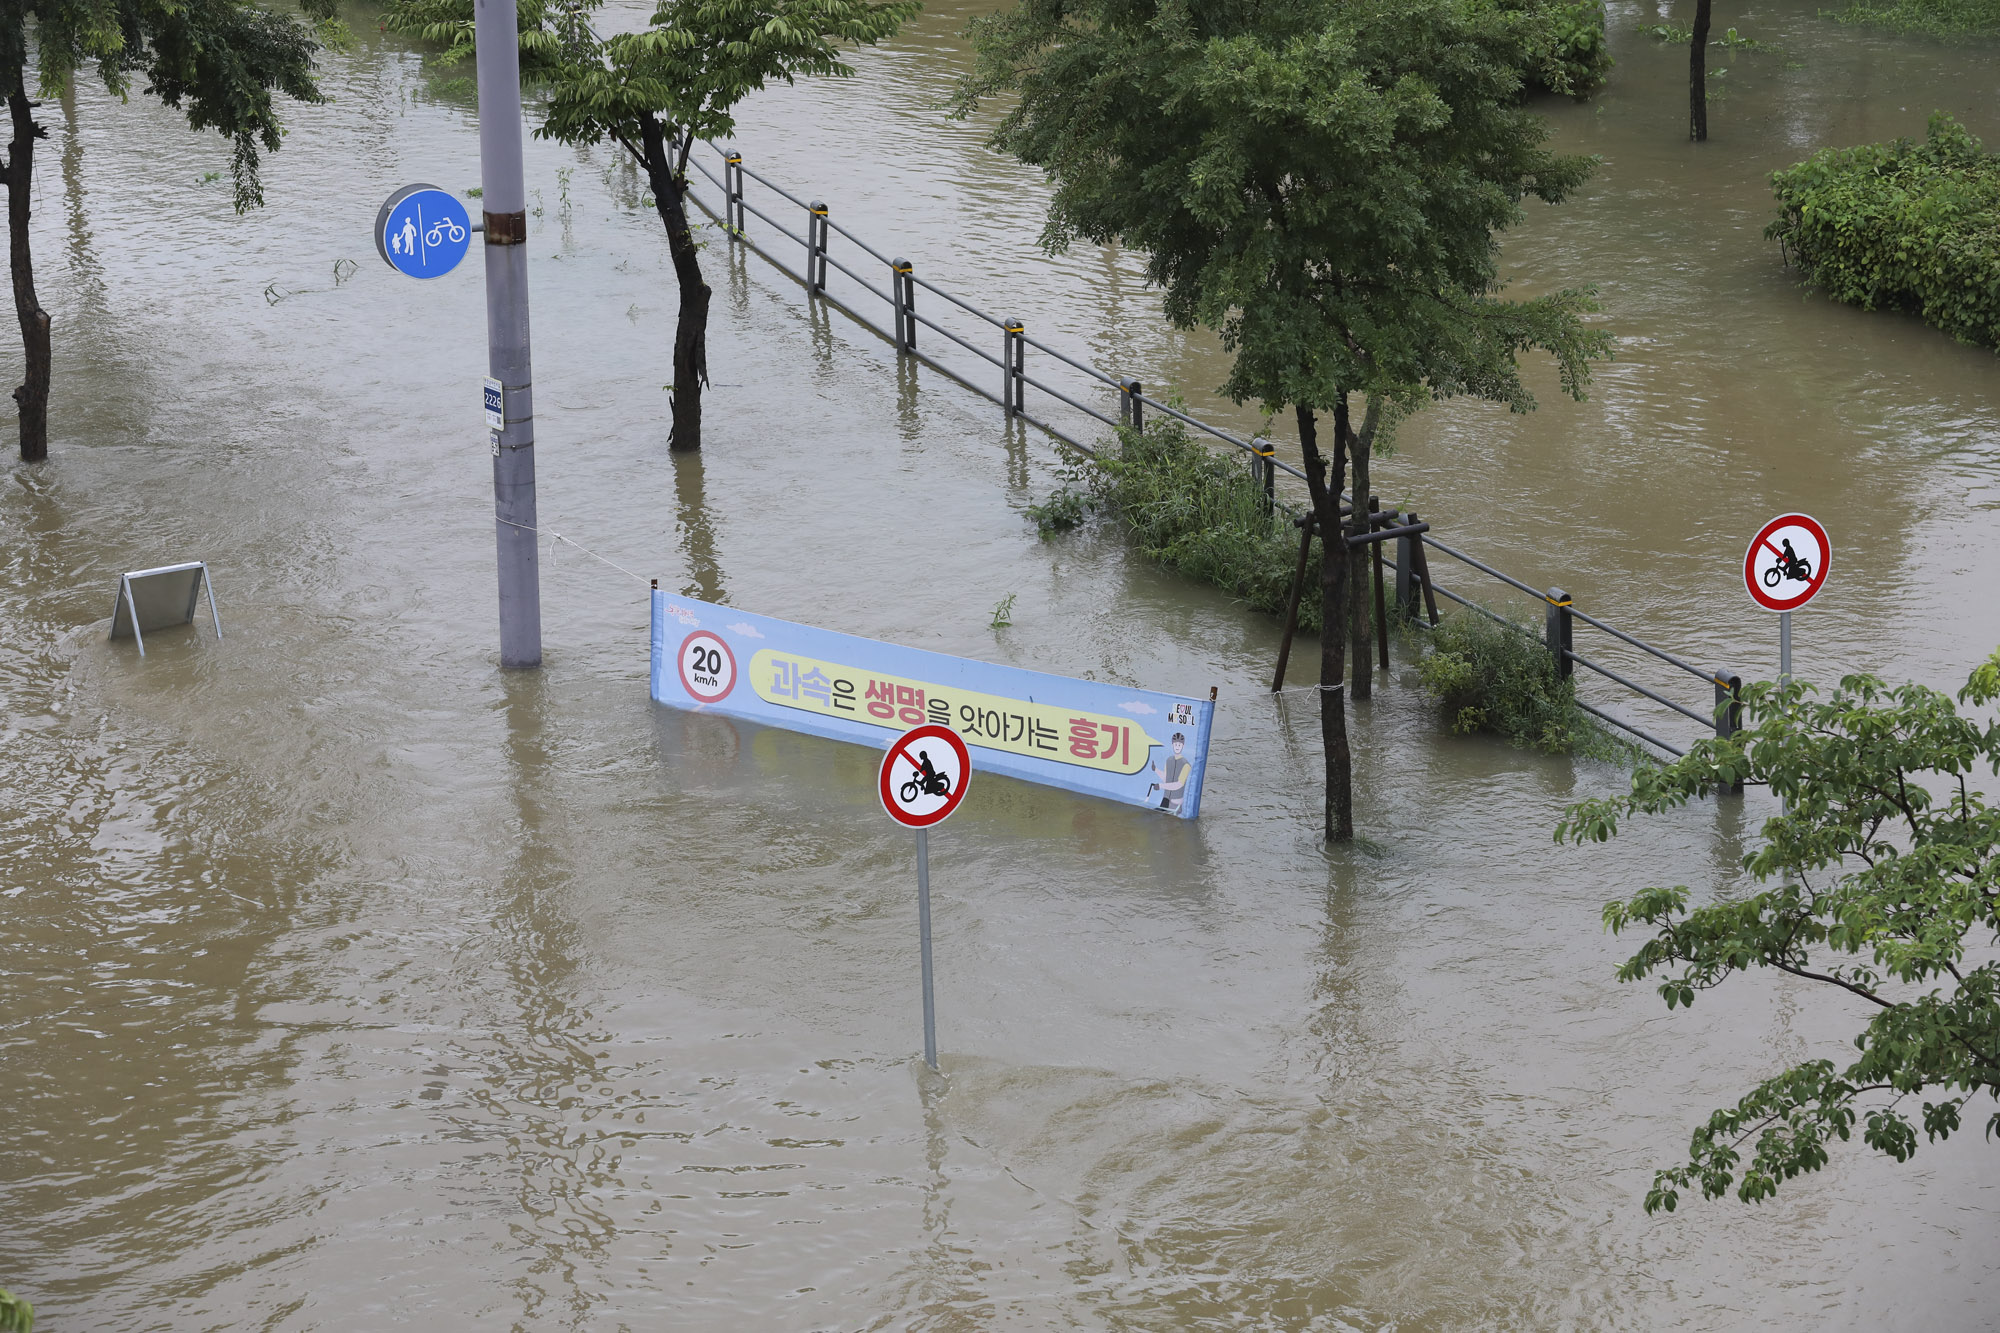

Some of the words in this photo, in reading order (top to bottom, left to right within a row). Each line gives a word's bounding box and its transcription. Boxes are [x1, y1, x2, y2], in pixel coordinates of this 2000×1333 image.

[485, 392, 502, 409] 2226
[692, 645, 721, 675] 20
[693, 673, 718, 687] km/h
[770, 659, 857, 711] 과속은
[864, 679, 951, 726] 생명을
[960, 704, 1059, 752] 앗아가는
[1068, 717, 1130, 766] 흉기
